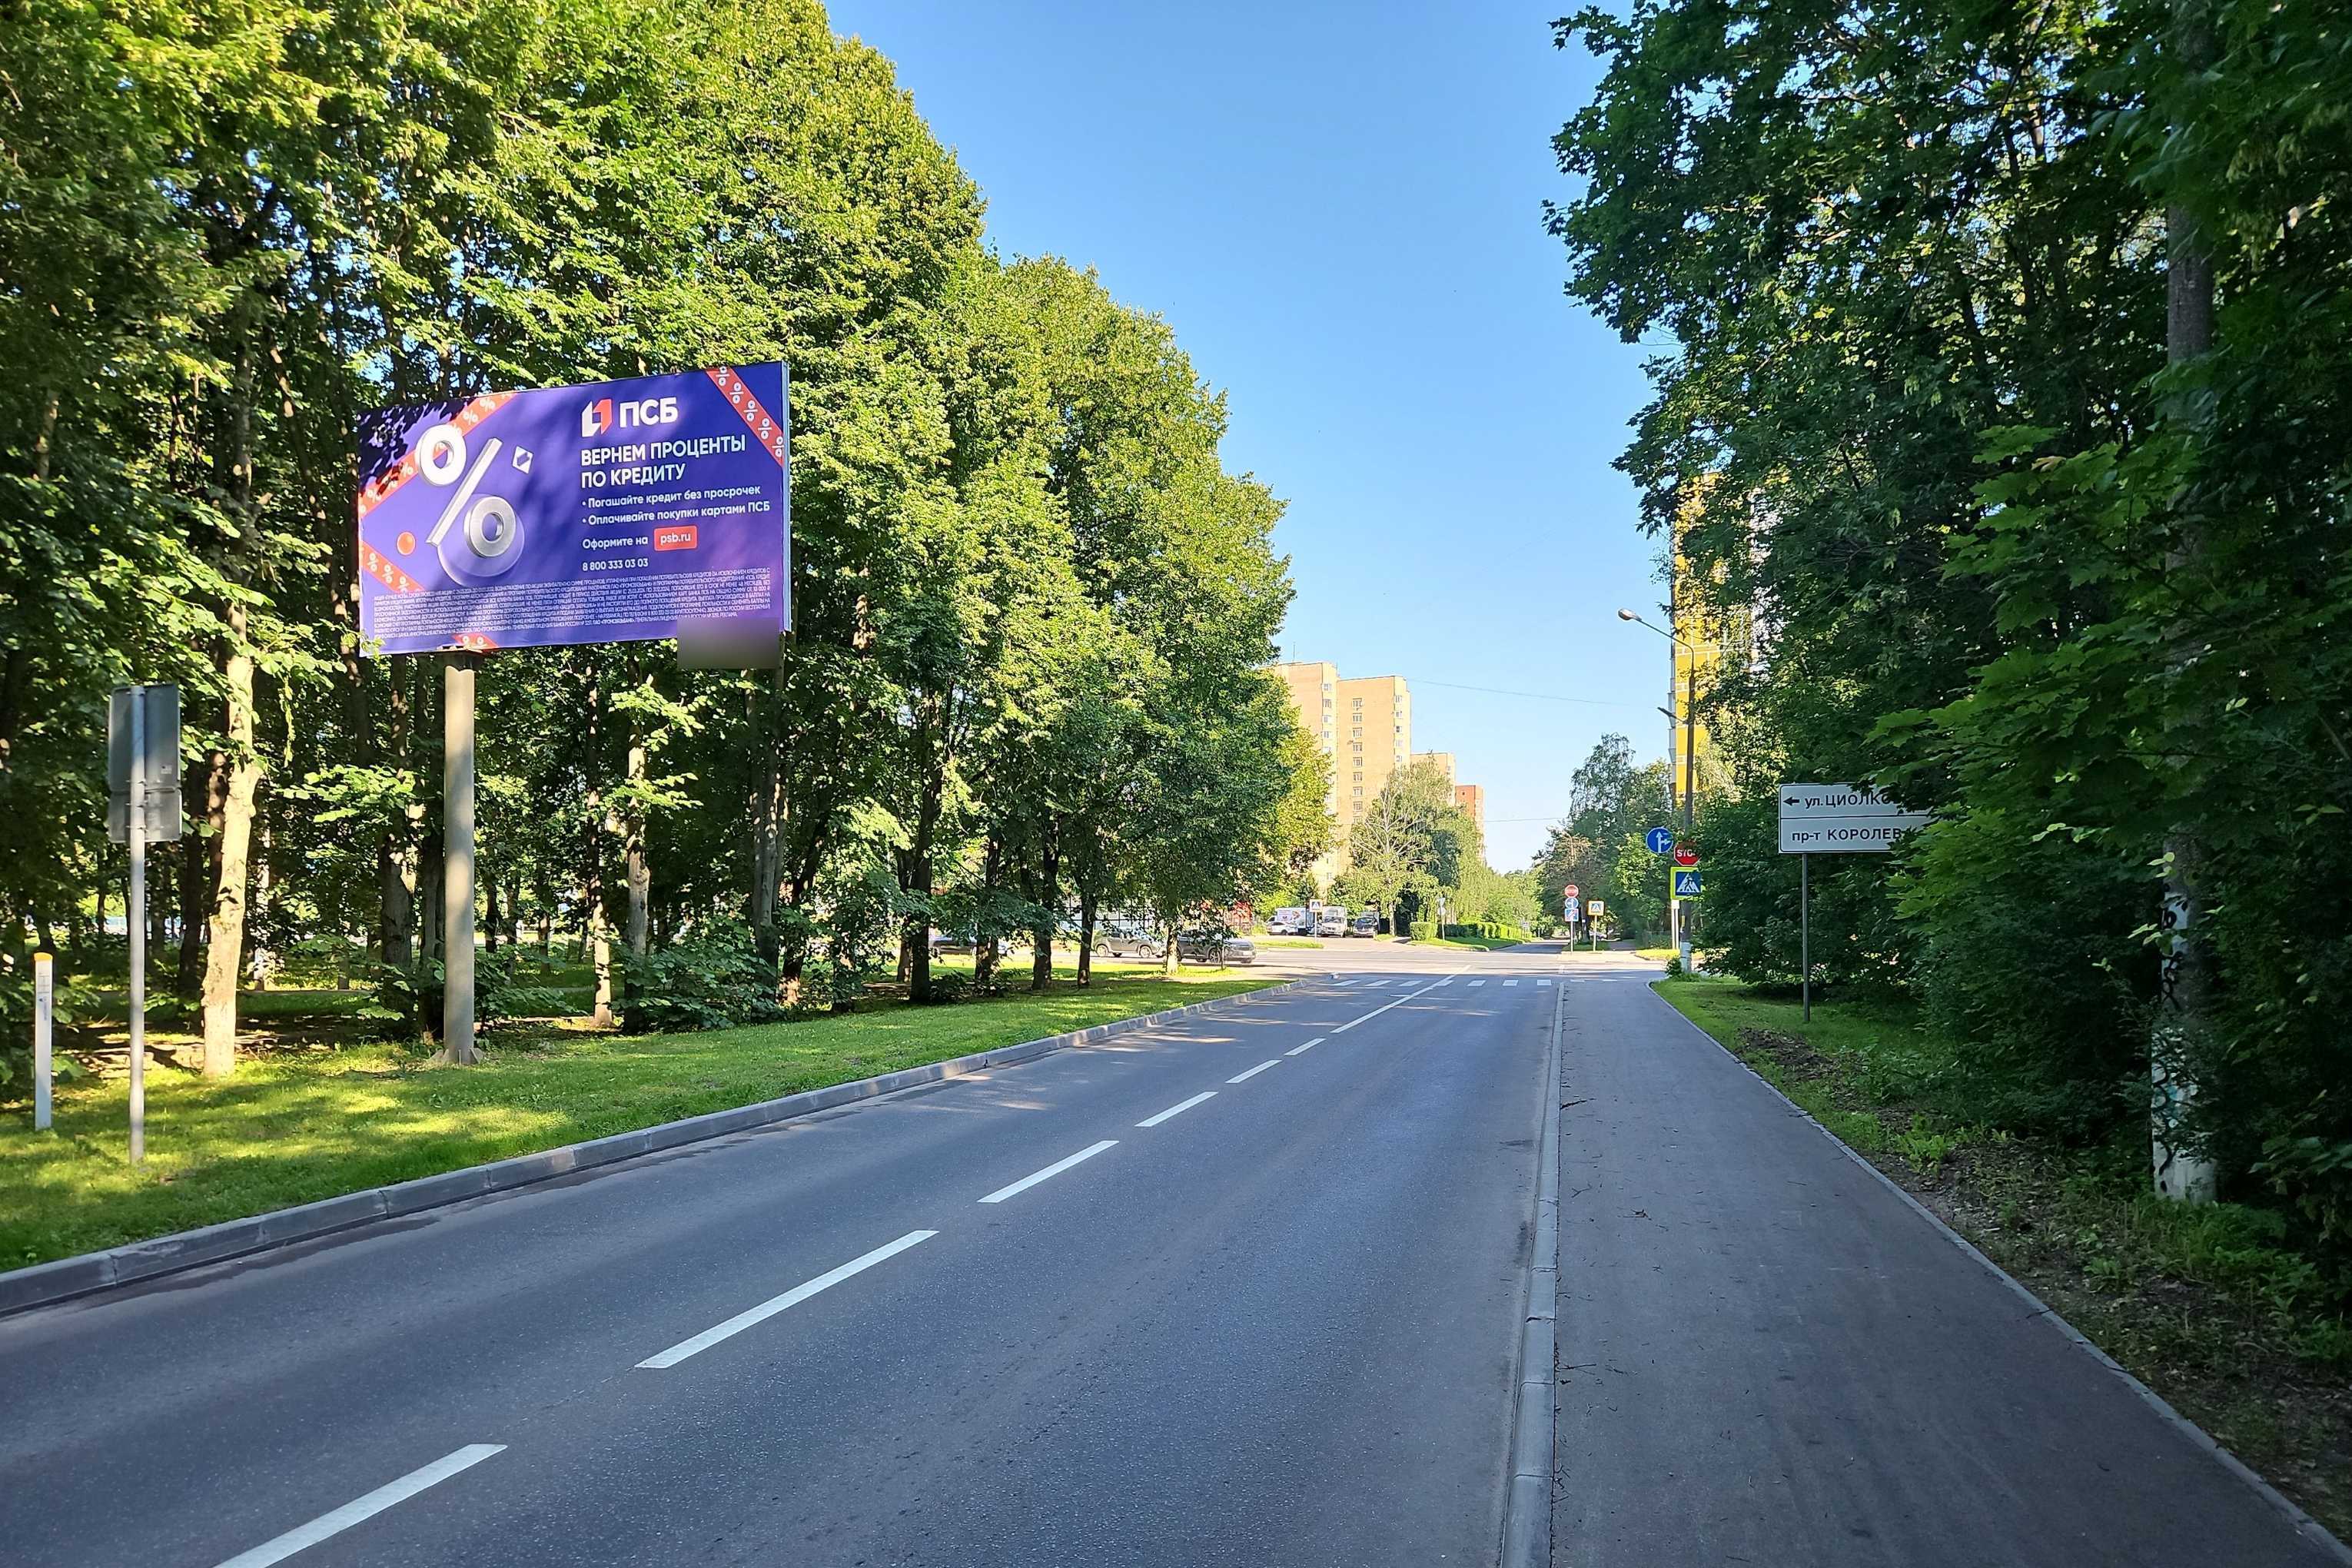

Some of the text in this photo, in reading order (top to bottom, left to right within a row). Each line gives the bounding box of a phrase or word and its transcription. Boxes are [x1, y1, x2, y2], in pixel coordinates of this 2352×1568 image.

[620, 397, 679, 427] ПСБ
[581, 434, 746, 467] ВЕРНЕМ ПРОЦЕНТЫ
[581, 463, 686, 488] ПО КРЕДИТУ
[588, 486, 761, 508] Погашайте кредит без просрочек
[588, 500, 770, 526] Оплачивайте покупки картами ПСБ
[583, 536, 649, 550] Оформите на
[660, 532, 691, 545] psb.ru
[582, 558, 649, 571] 8 800 333 03 03
[1805, 792, 1900, 808] ул. ЦИОЛКО
[1792, 828, 1902, 843] пр-т КОРОЛЕВ
[1676, 849, 1696, 857] STO
